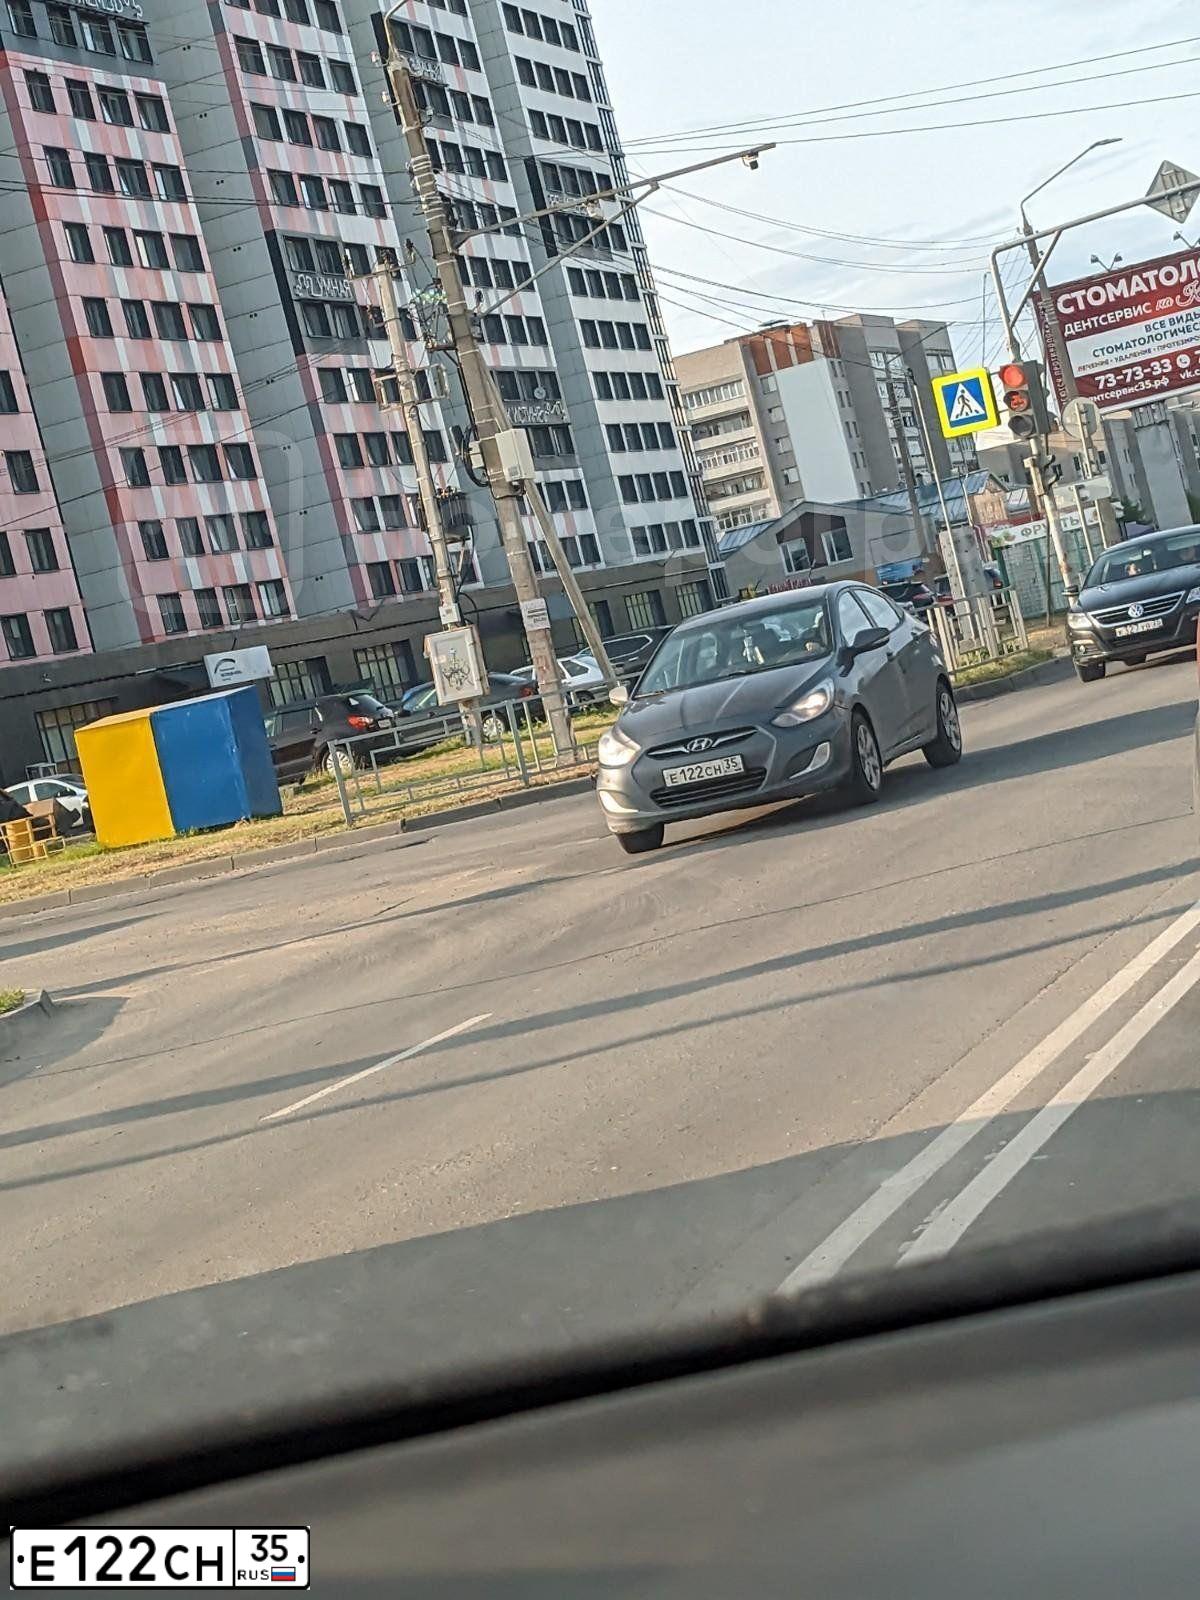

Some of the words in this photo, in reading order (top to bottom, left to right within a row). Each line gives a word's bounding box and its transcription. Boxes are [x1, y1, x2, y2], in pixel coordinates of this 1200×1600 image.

[1057, 257, 1200, 314] СТОМАТОЛ
[1064, 302, 1152, 337] ДЕНТСЕРВИС
[1145, 319, 1166, 333] ВСЕ
[1092, 322, 1200, 358] СТОМАТОЛОГИЧЕС
[1094, 358, 1172, 390] 73-73-33
[1021, 514, 1079, 537] ФРТЫ
[669, 764, 722, 784] Е122СН
[723, 757, 738, 770] 35
